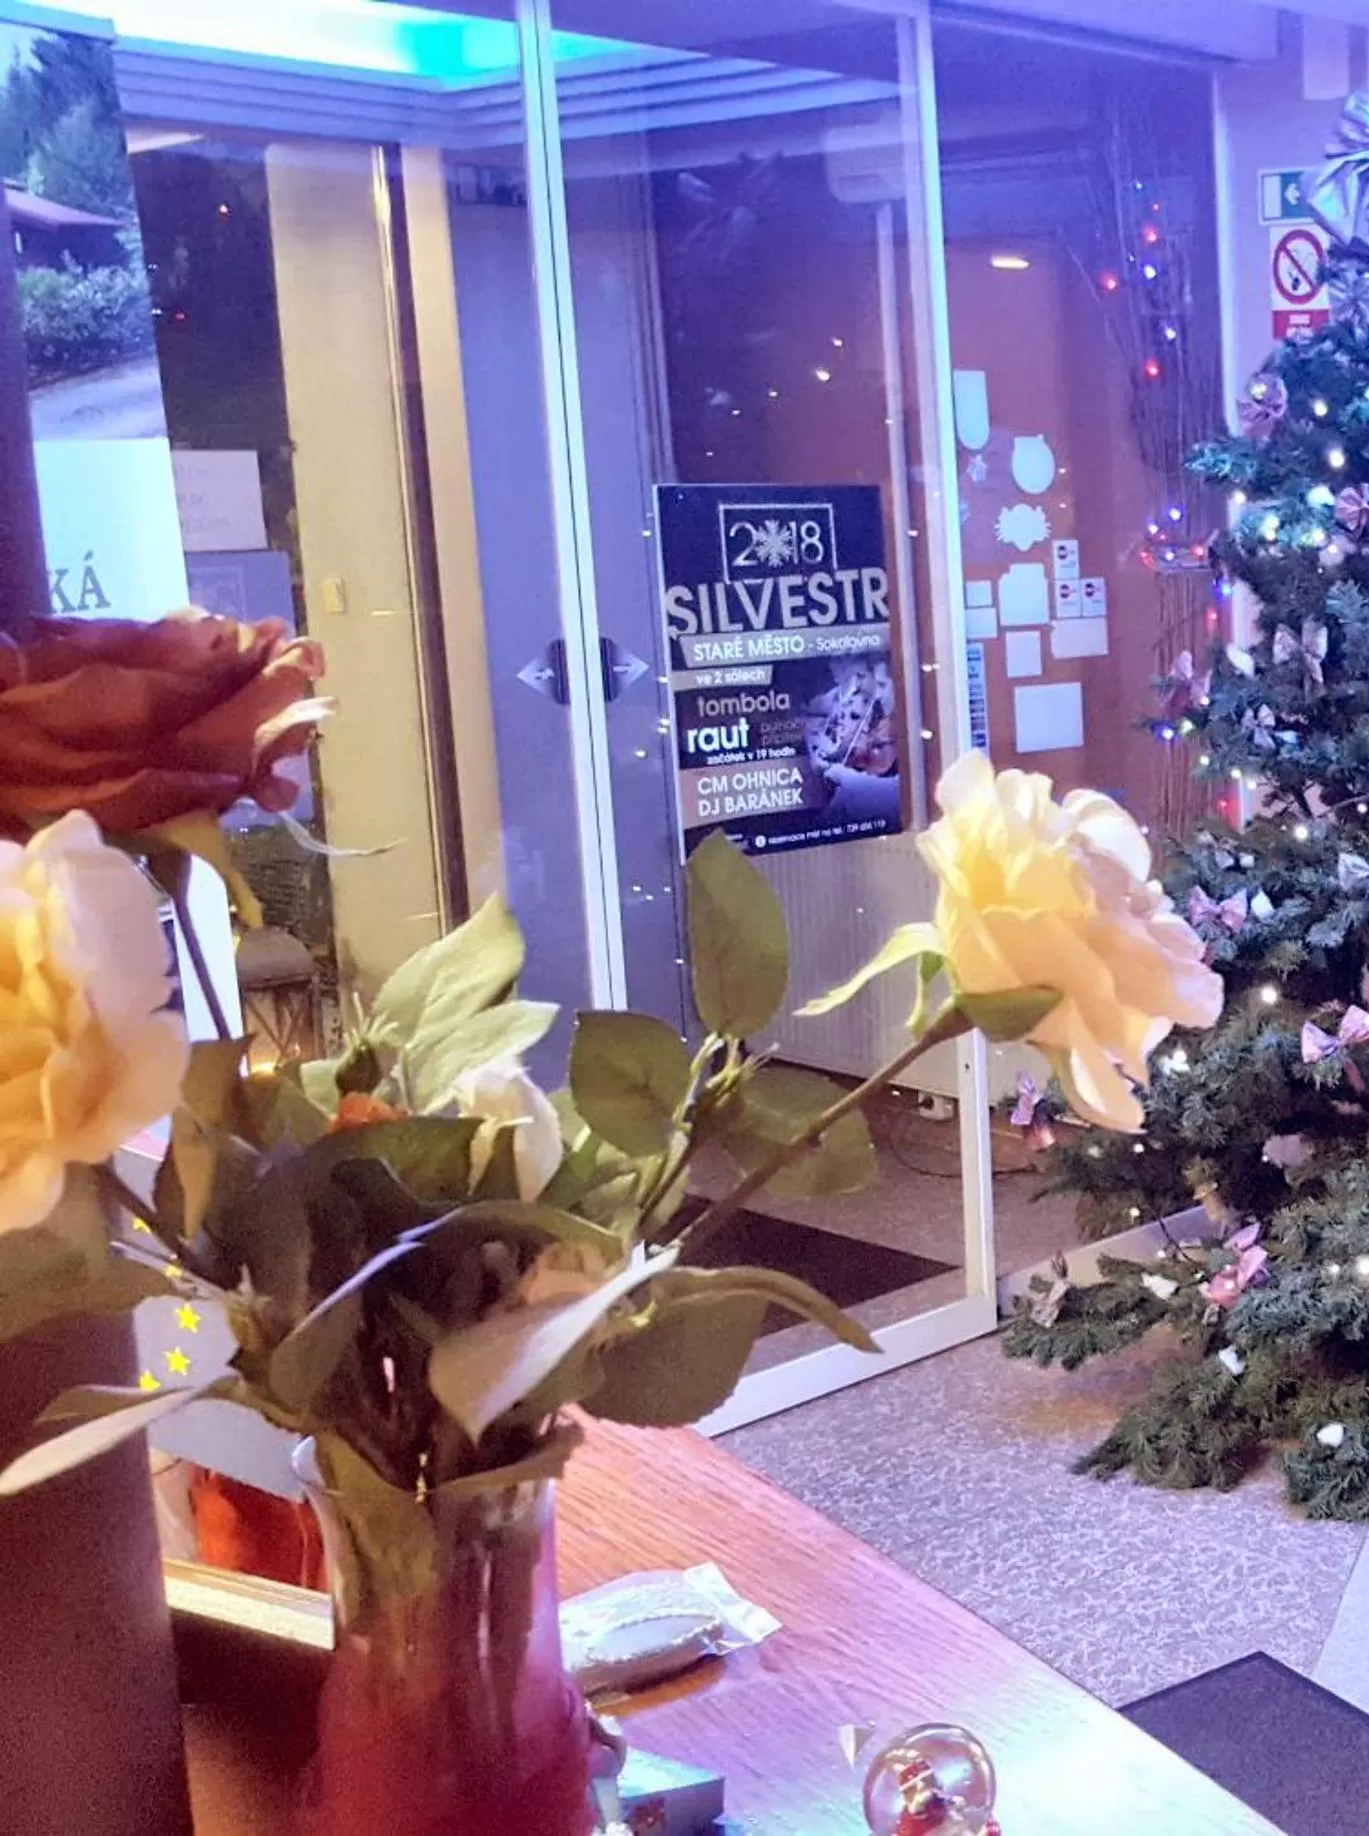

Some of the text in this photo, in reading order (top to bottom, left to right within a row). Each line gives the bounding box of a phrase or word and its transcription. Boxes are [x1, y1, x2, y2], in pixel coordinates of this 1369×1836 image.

[729, 519, 824, 567] 218
[666, 567, 890, 636] SILVESTR
[693, 635, 744, 662] STARÉ
[748, 633, 805, 658] MĚSTO
[697, 689, 790, 718] tombola
[687, 717, 750, 753] raut
[698, 767, 804, 795] CM OHNICA
[699, 787, 804, 818] DJ BARÁNEK
